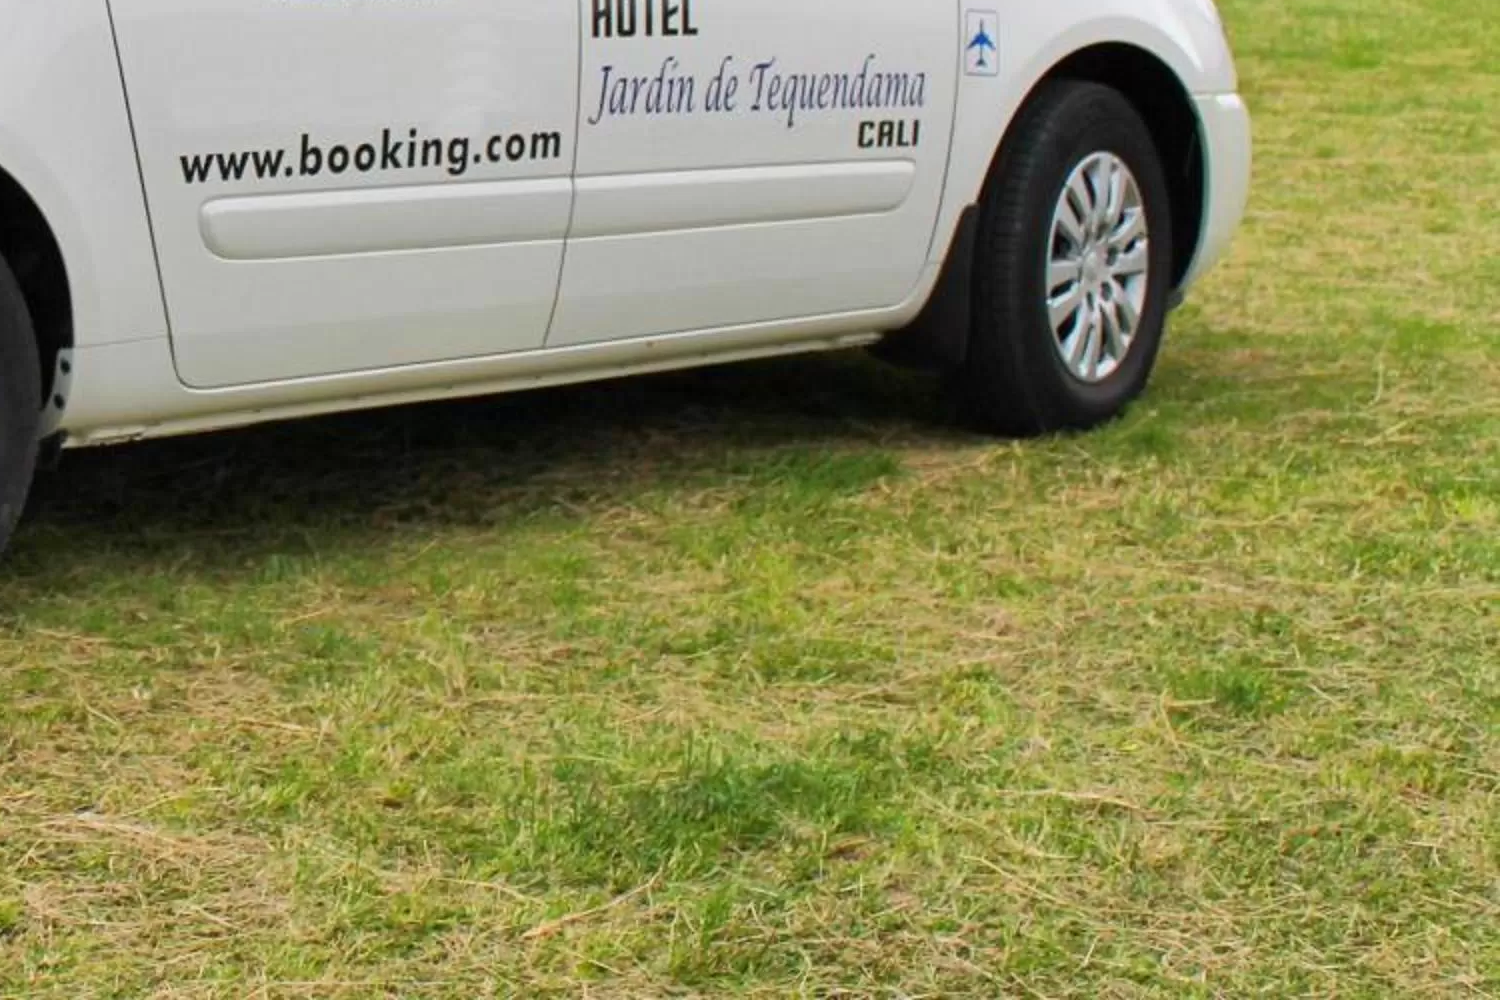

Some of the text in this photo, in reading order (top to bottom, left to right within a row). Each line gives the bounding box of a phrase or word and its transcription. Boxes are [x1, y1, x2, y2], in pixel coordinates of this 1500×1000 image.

[587, 53, 925, 128] Jardín de Tequendama
[180, 127, 562, 184] www.booking.com
[857, 119, 920, 148] CALI
